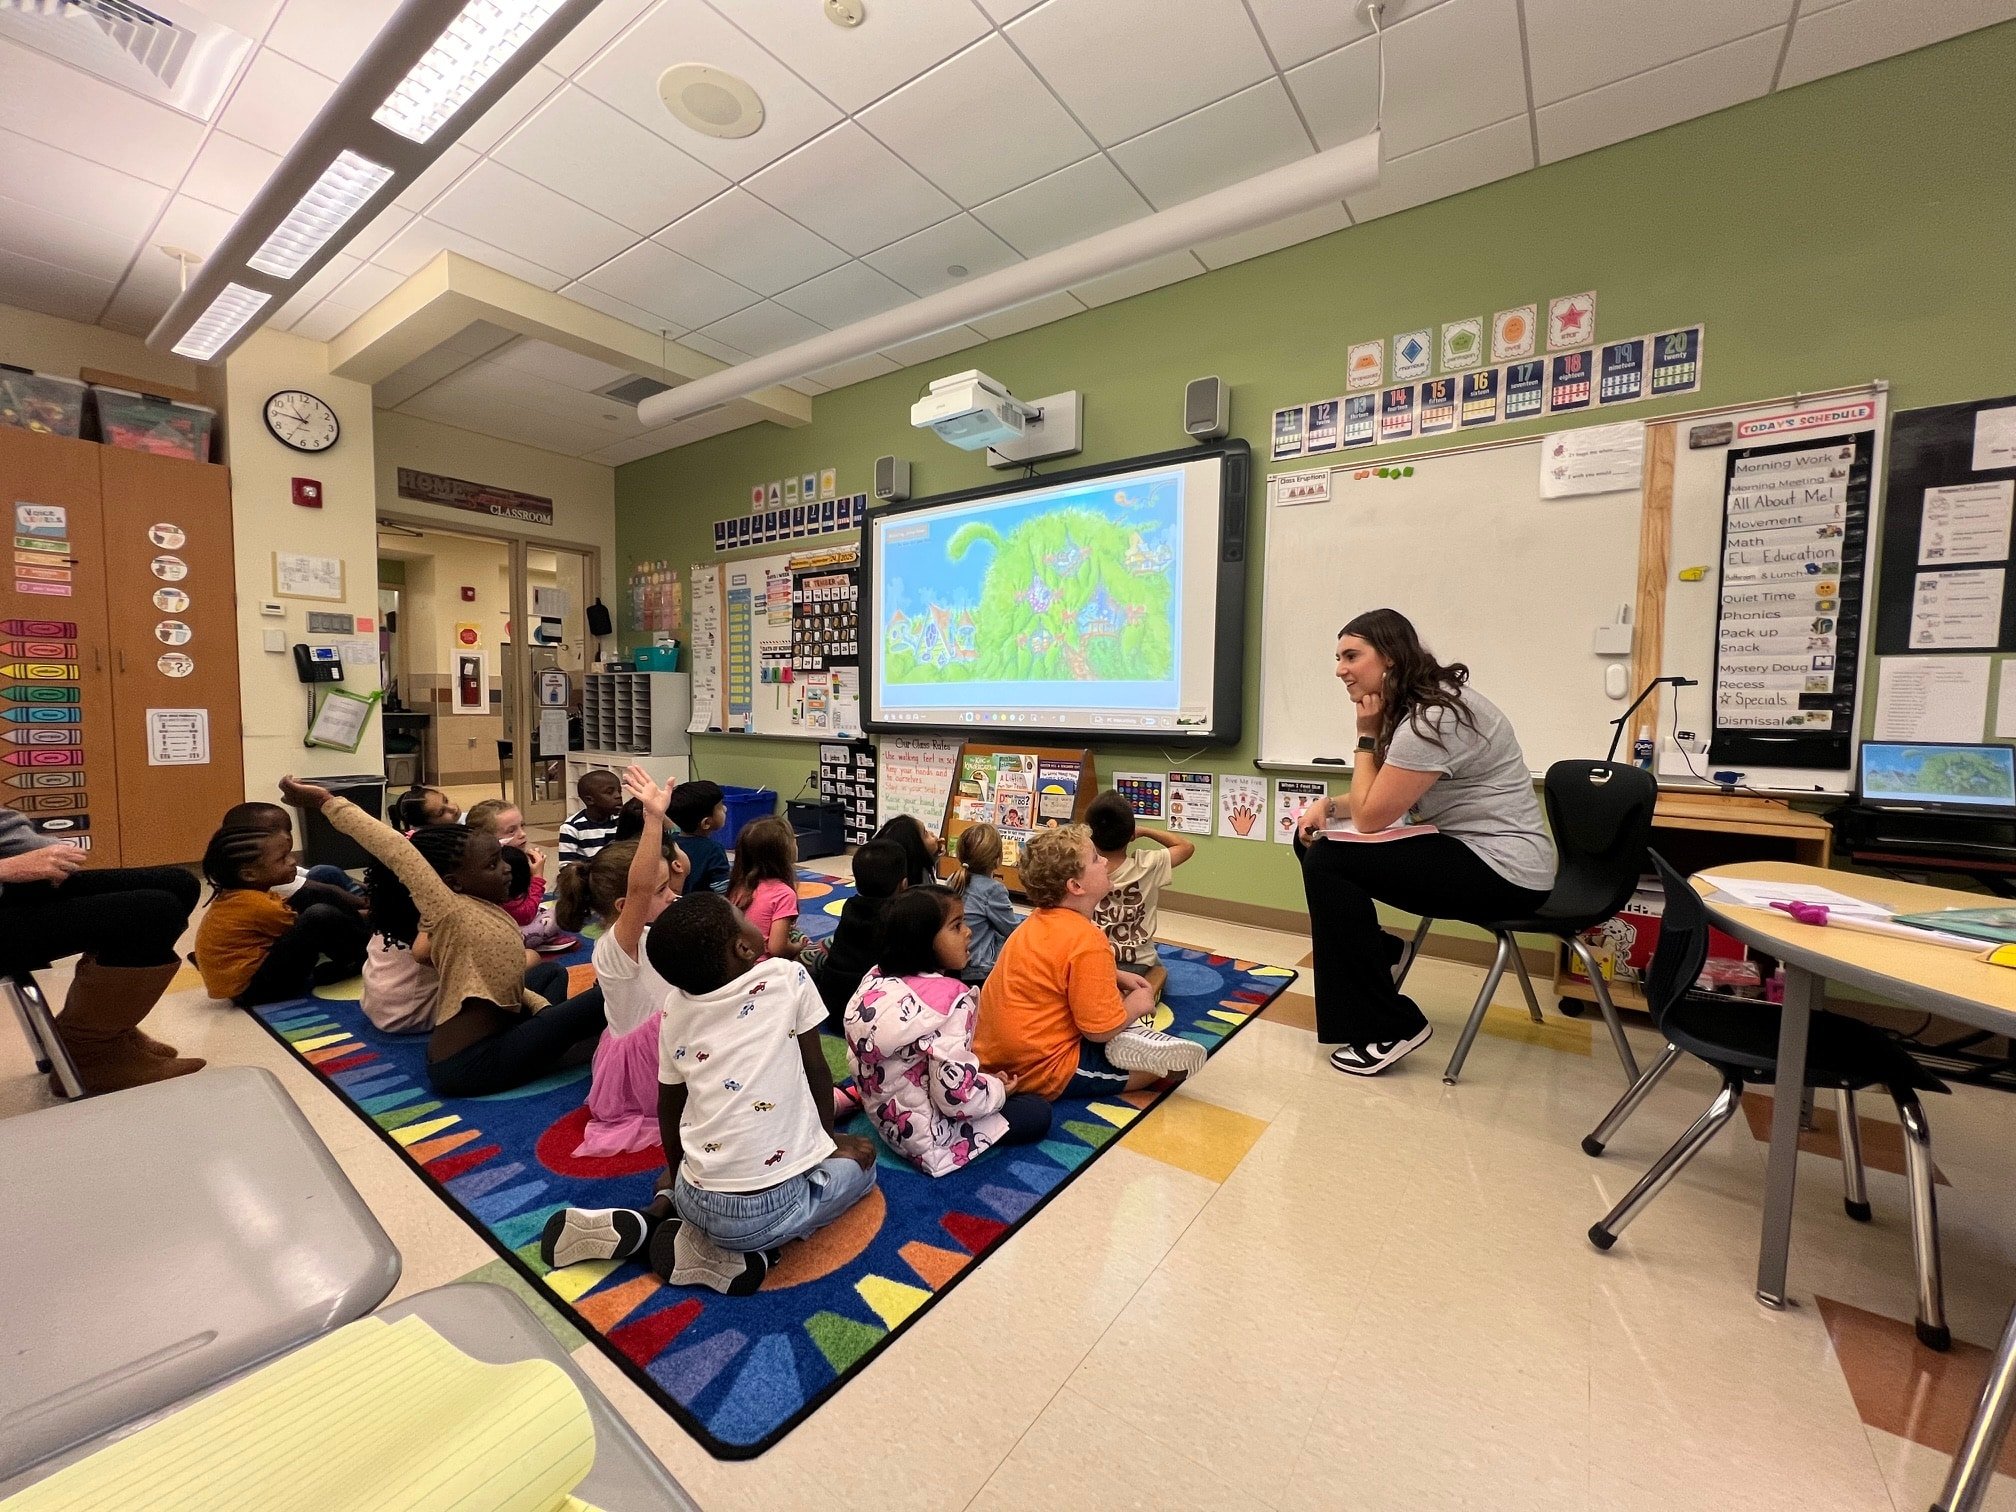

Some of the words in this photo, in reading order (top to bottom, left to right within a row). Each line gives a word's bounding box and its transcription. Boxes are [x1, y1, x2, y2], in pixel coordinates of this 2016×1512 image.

[1664, 332, 1688, 355] 20
[1614, 343, 1633, 364] 19
[1663, 351, 1687, 361] twenty
[1564, 353, 1582, 374] 18
[1608, 361, 1636, 372] nineteen
[1517, 363, 1534, 382] 17
[1558, 371, 1585, 381] eighteen
[1473, 371, 1489, 391] 16
[1510, 379, 1539, 389] seventeen
[1430, 380, 1446, 399] 15
[287, 395, 294, 403] 11
[300, 395, 310, 404] 12
[1390, 388, 1407, 406] 14
[274, 400, 284, 408] 10
[315, 402, 319, 410] 1
[1353, 397, 1367, 414] 13
[271, 409, 278, 417] 9
[324, 413, 330, 421] 2
[1317, 403, 1330, 420] 12
[1284, 410, 1295, 427] 11
[1743, 418, 1795, 433] TODAY'S
[1799, 408, 1866, 425] SCHEDULE
[275, 421, 282, 429] 8
[286, 432, 293, 440] 7
[1736, 459, 1791, 473] Morning
[1795, 453, 1833, 466] Work
[400, 470, 466, 498] HOME
[1280, 476, 1296, 485] Class
[1296, 473, 1326, 483] Eruptions
[1731, 481, 1776, 492] Morning
[1778, 475, 1825, 487] Meeting
[1733, 496, 1749, 510] All
[1754, 490, 1796, 509] About
[1805, 487, 1833, 503] Me!
[24, 508, 55, 516] Voice
[490, 504, 552, 524] CLASSROOM
[1729, 515, 1803, 529] Movement
[1728, 537, 1764, 549] Math
[1728, 551, 1751, 565] EL
[1763, 545, 1835, 564] Education
[1770, 570, 1803, 579] Lunch
[1722, 594, 1758, 604] Quiet
[1761, 592, 1796, 601] Time
[1723, 611, 1781, 620] Phonics
[1721, 628, 1755, 638] Pack
[1759, 629, 1779, 637] up
[1720, 643, 1760, 653] Snack
[1720, 664, 1769, 675] Mystery
[1772, 663, 1808, 674] Doug
[1719, 680, 1765, 689] Recess
[1735, 691, 1788, 710] Specials
[1718, 716, 1785, 726] Dismissal
[895, 737, 911, 749] Our
[912, 739, 930, 749] Class
[932, 739, 951, 751] Rules
[884, 751, 895, 760] Use
[898, 752, 919, 764] walking
[886, 764, 898, 775] Keep
[900, 768, 912, 776] your
[915, 766, 933, 776] hands
[895, 776, 922, 784] ourselves
[927, 821, 939, 830] and
